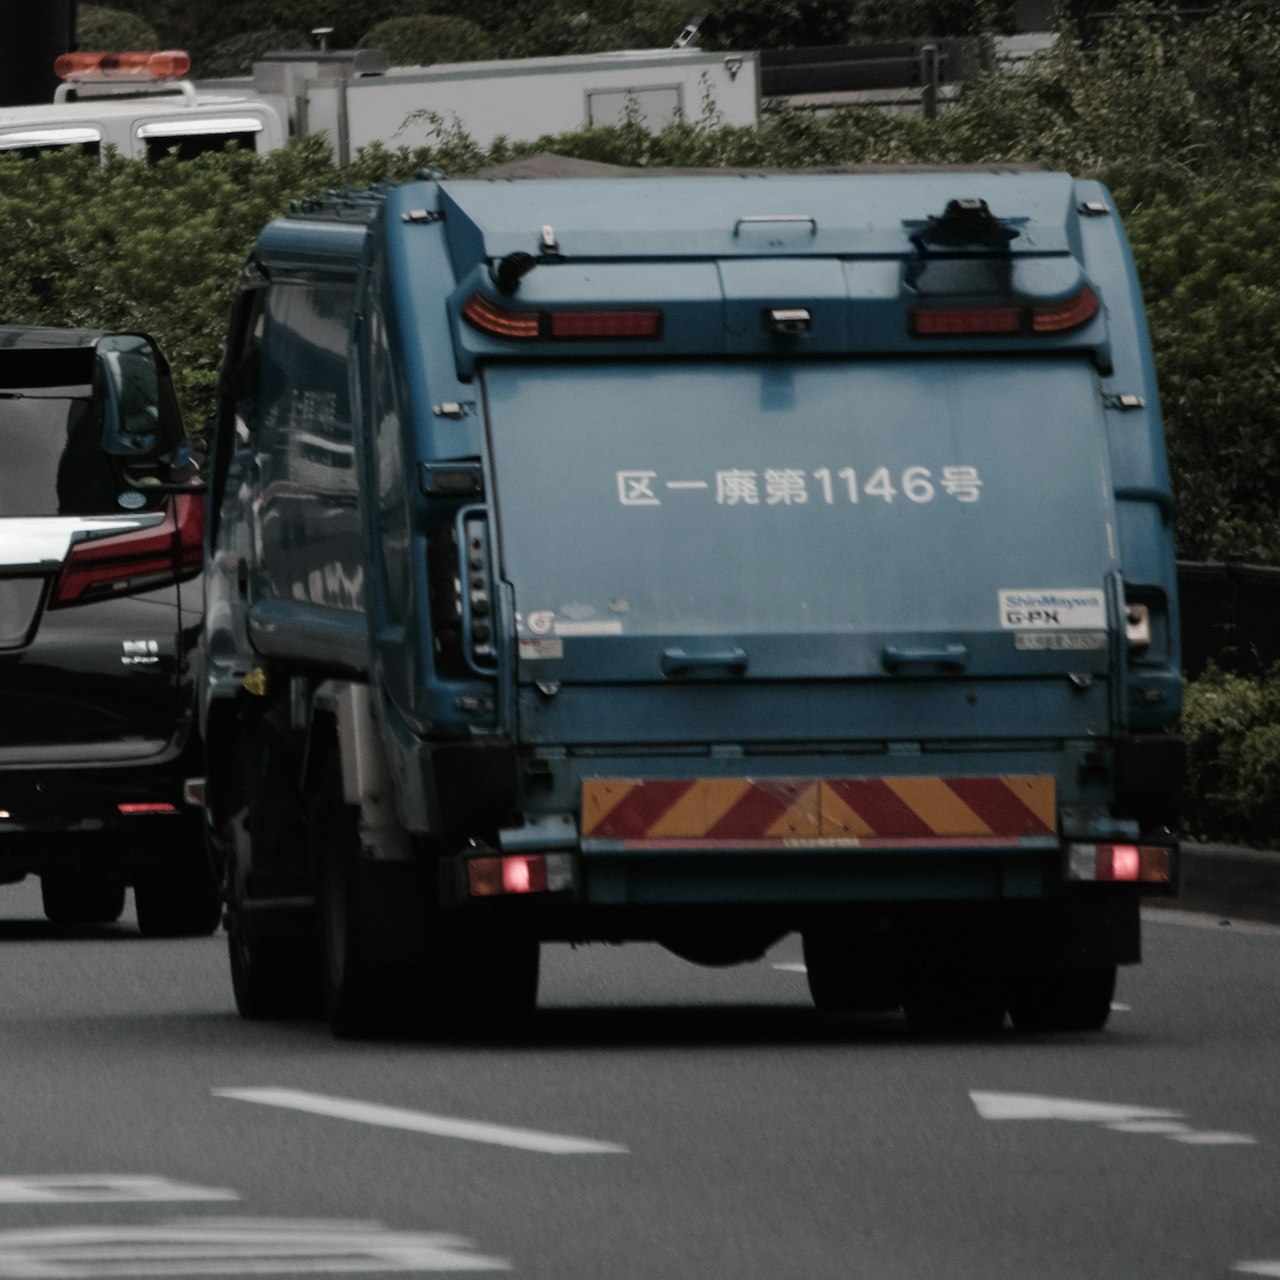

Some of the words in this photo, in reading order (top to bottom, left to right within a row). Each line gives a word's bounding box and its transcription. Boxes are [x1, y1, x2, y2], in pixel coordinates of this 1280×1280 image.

[617, 466, 983, 506] 区一廃第1146号
